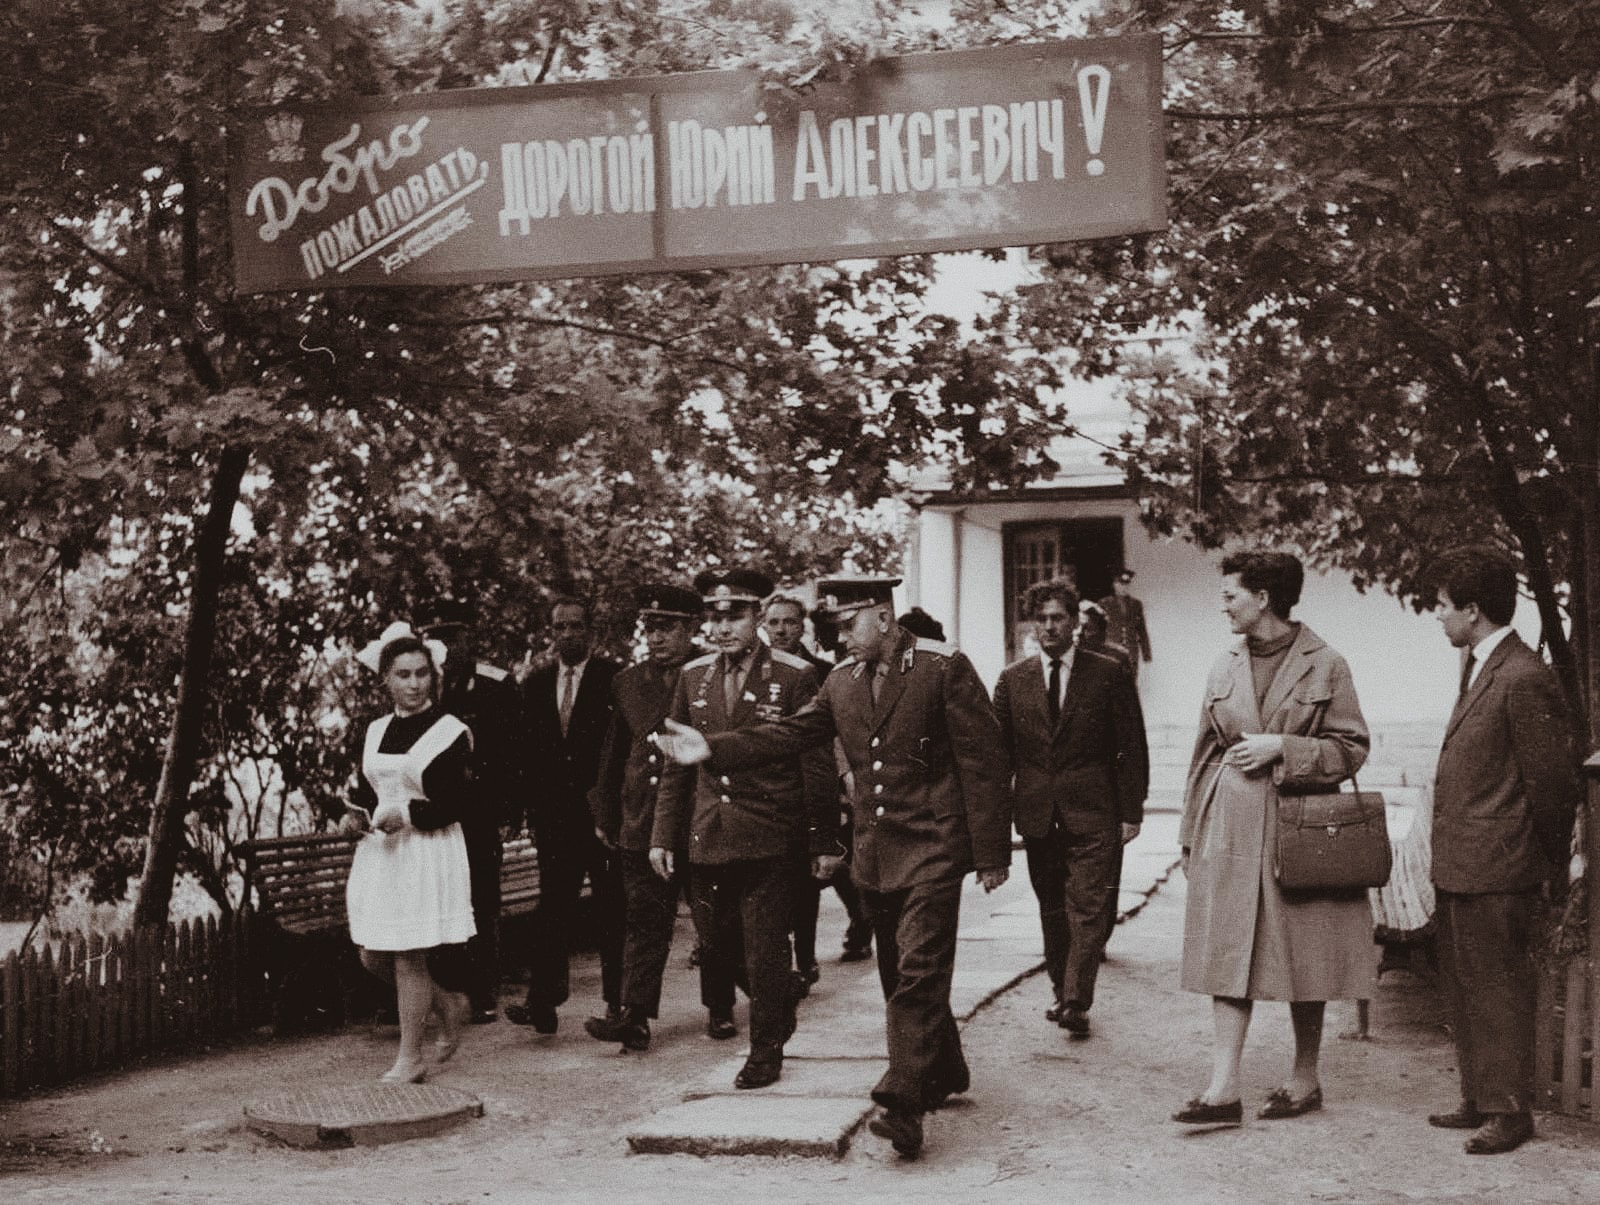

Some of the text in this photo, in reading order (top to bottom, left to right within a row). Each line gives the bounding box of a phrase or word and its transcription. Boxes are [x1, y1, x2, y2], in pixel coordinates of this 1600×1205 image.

[246, 116, 430, 241] Добро
[301, 148, 489, 279] ПОЖАЛОВАТЬ,
[499, 120, 655, 236] ДОРОГОЙ
[667, 112, 776, 209] ЮРИЙ
